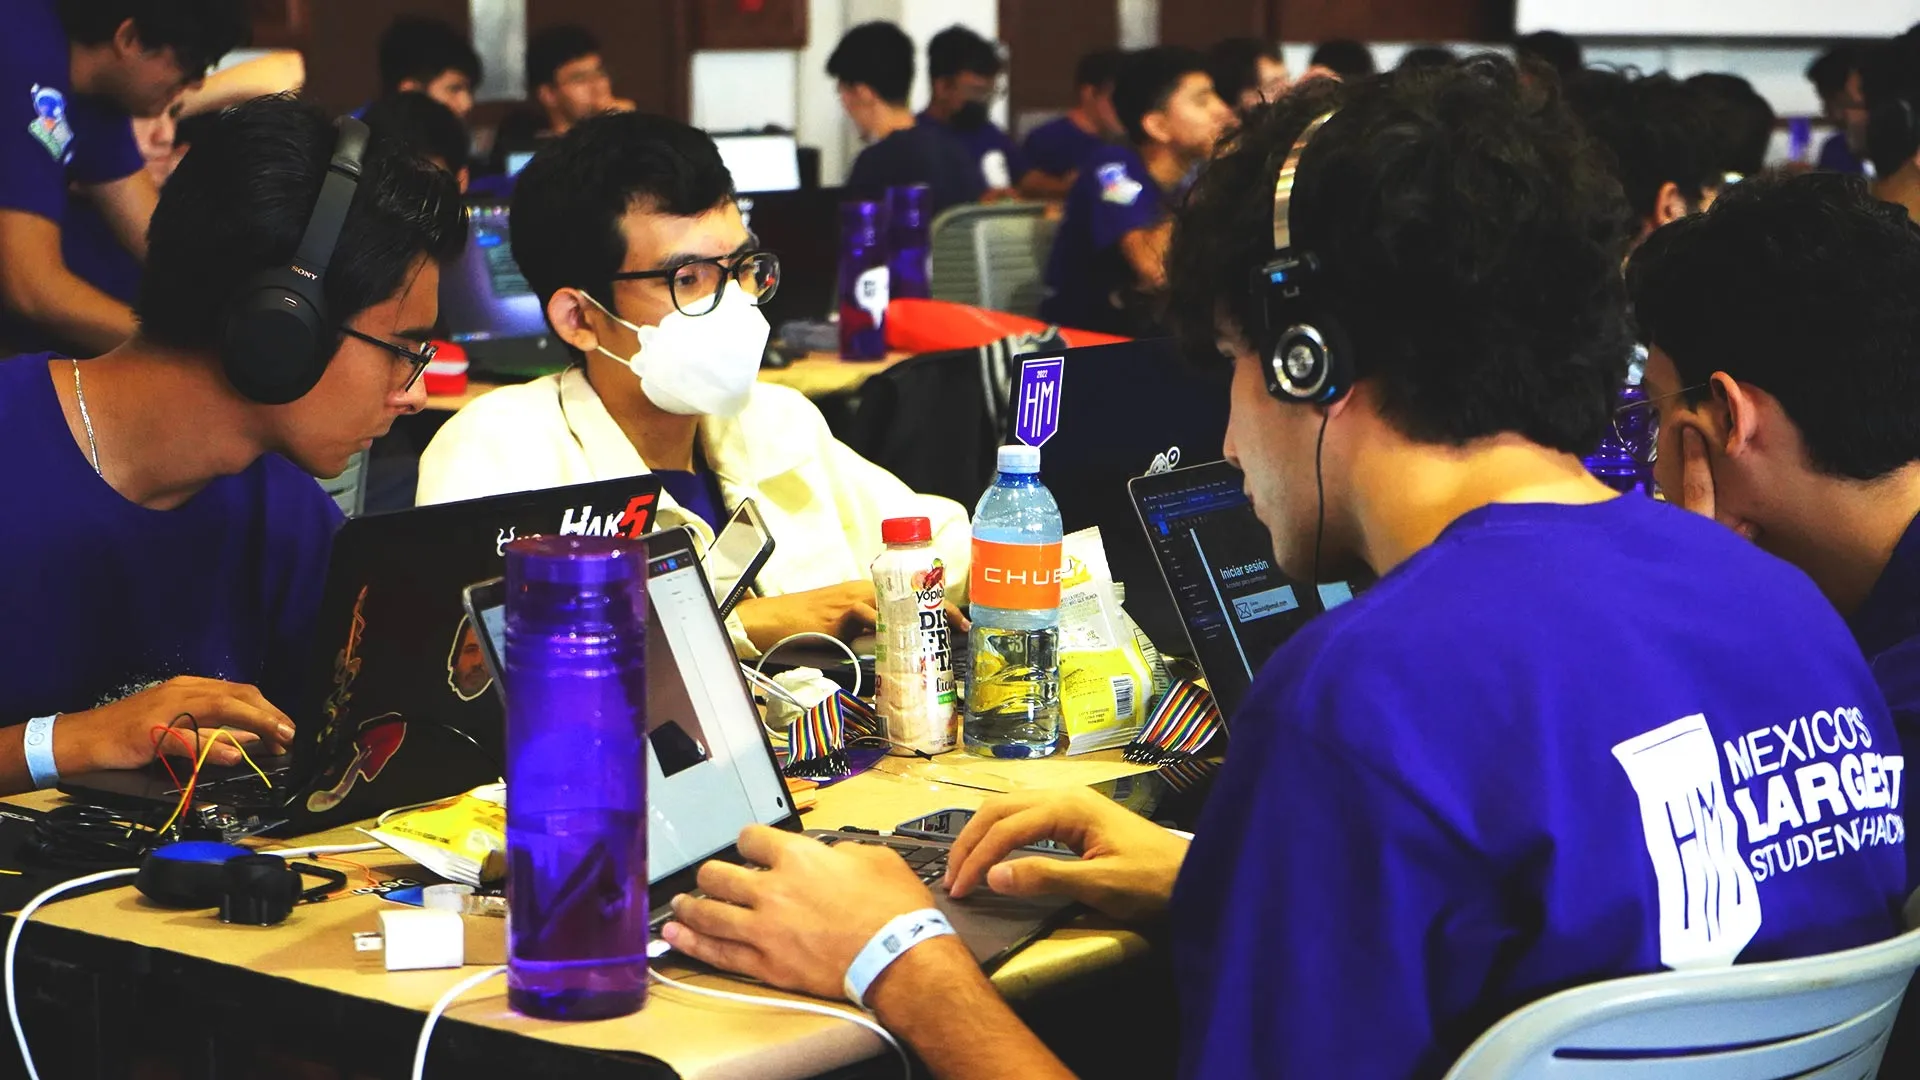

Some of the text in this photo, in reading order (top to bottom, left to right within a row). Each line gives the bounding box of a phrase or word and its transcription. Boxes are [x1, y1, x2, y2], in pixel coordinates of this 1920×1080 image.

[291, 265, 318, 281] SONY
[1023, 380, 1055, 438] HM
[559, 493, 655, 539] HAK5
[1219, 558, 1270, 580] Iniciar sesión
